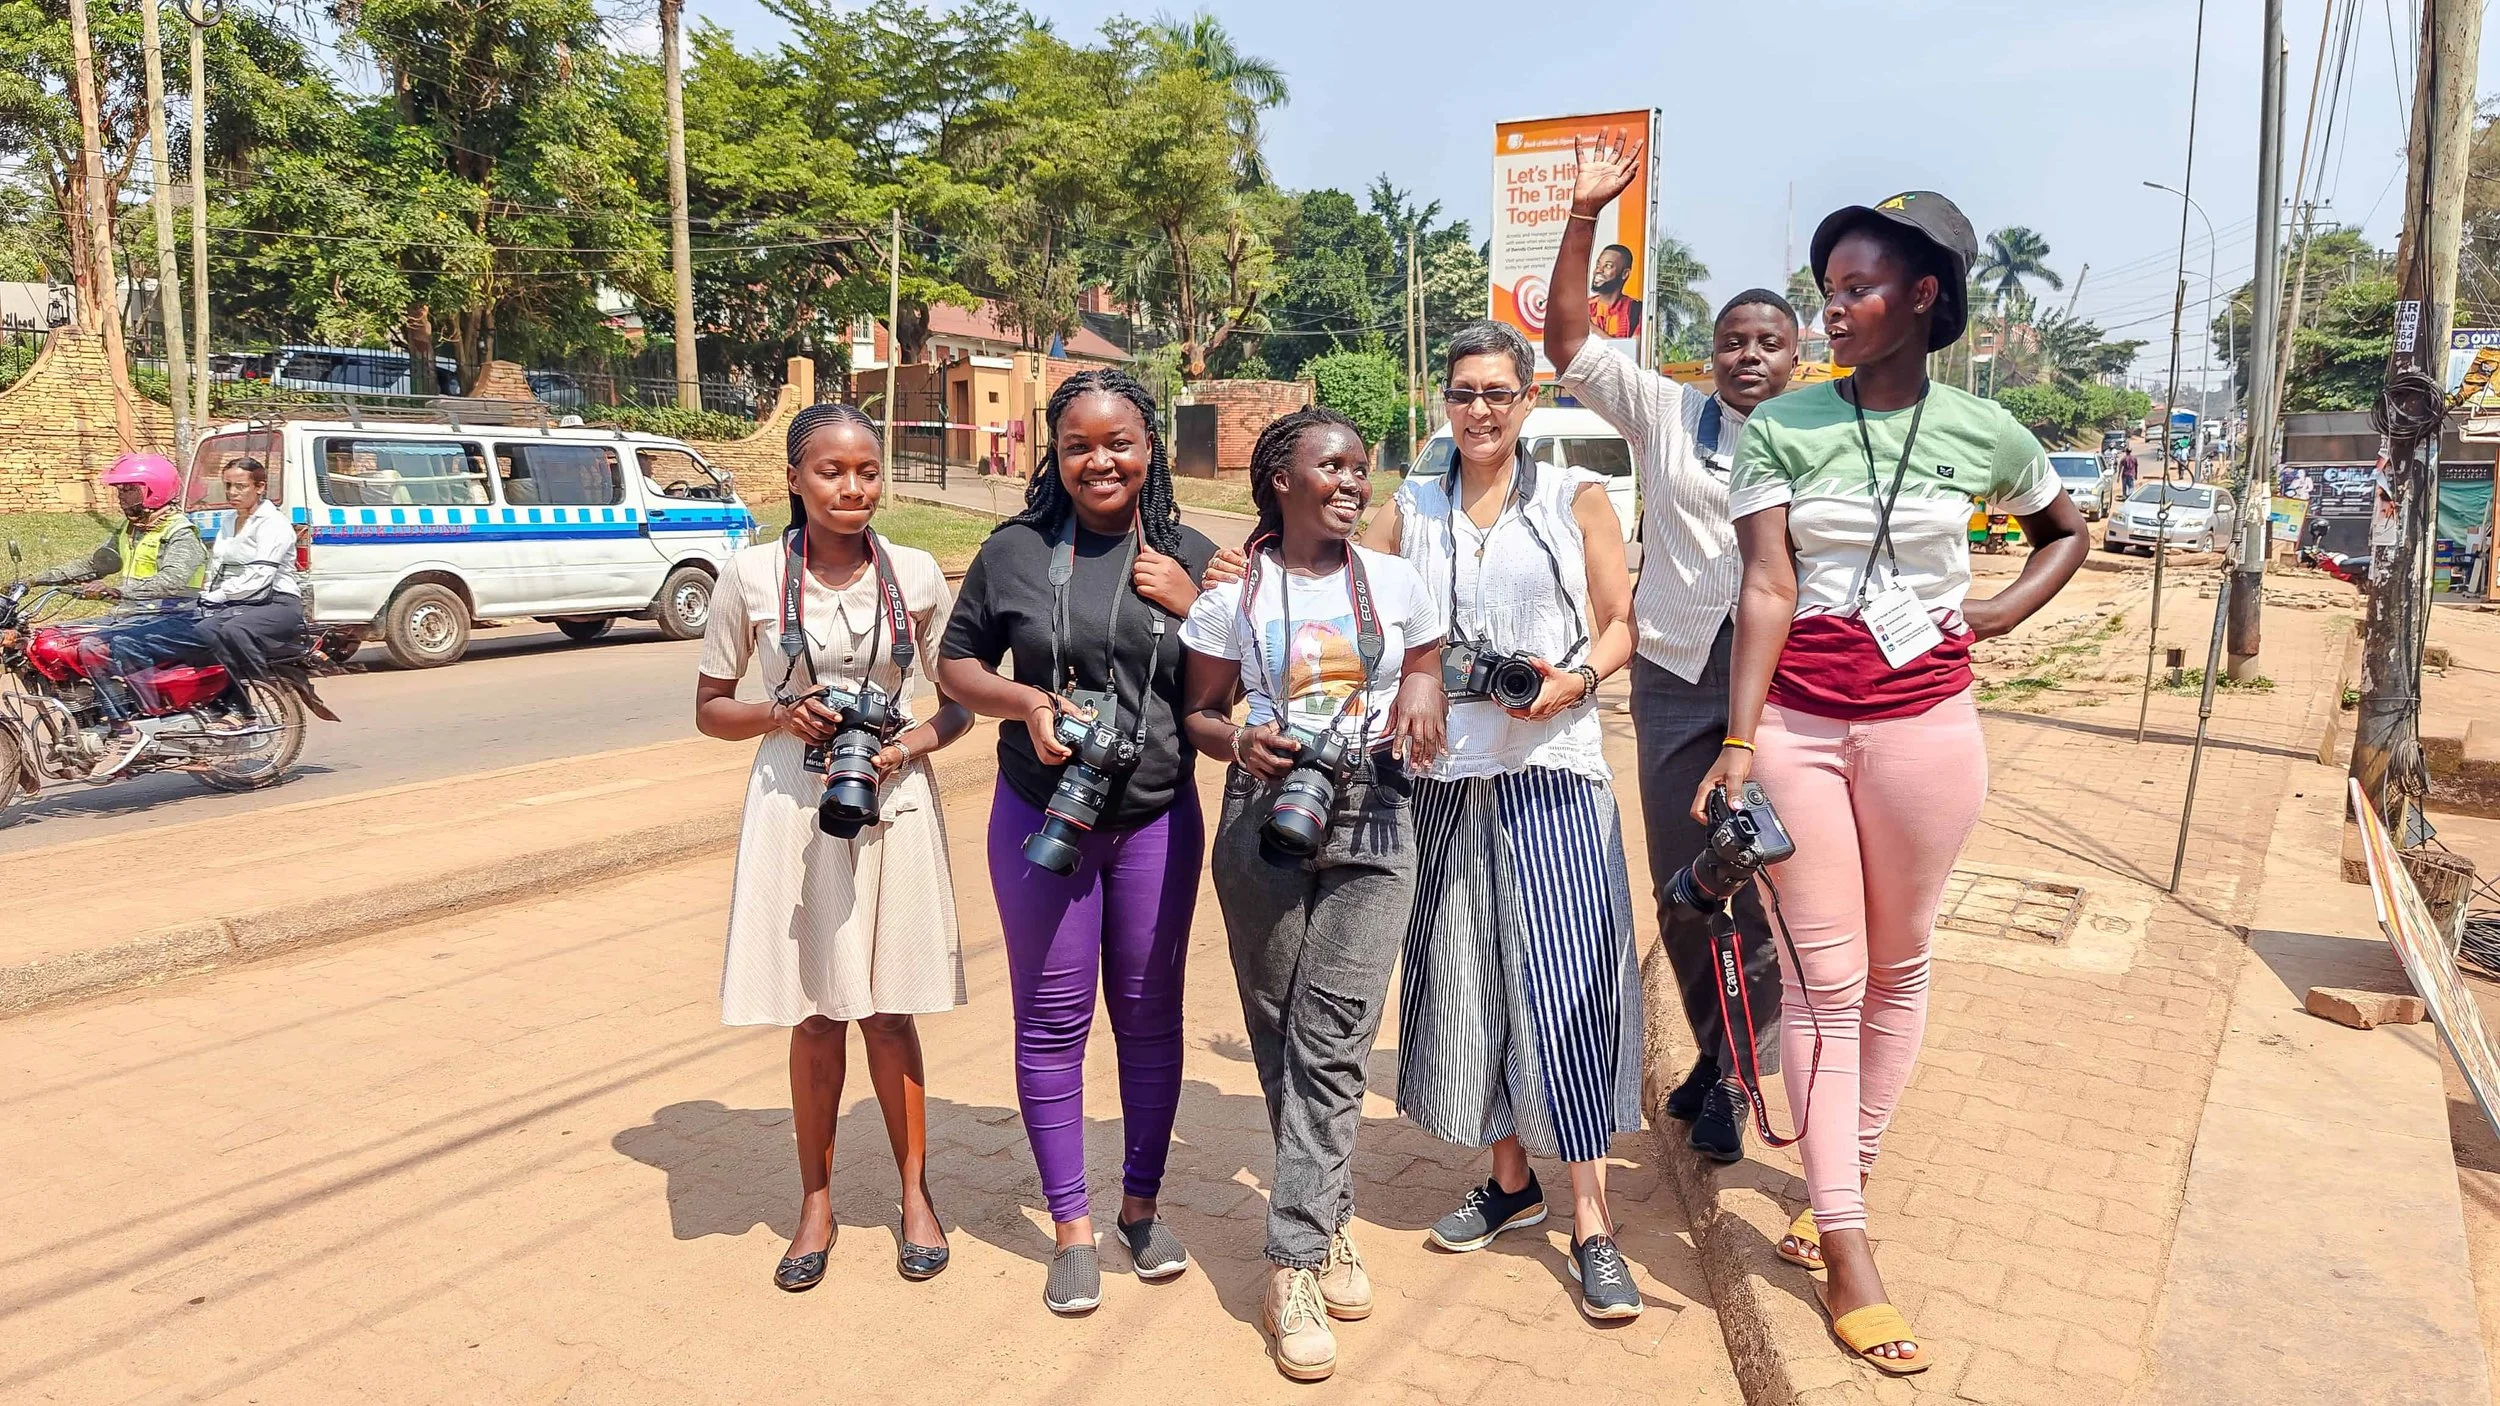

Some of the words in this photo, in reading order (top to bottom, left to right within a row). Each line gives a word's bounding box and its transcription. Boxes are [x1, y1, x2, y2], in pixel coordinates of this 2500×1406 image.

[1507, 165, 1547, 184] Let's
[1553, 163, 1577, 181] Hit
[1506, 187, 1540, 204] The
[1545, 185, 1573, 201] Tar
[1506, 204, 1571, 227] Togeth
[887, 583, 899, 598] 6D
[1355, 580, 1366, 594] 6D
[893, 600, 906, 630] EOS
[1358, 594, 1372, 621] EOS
[1722, 950, 1738, 997] Canon
